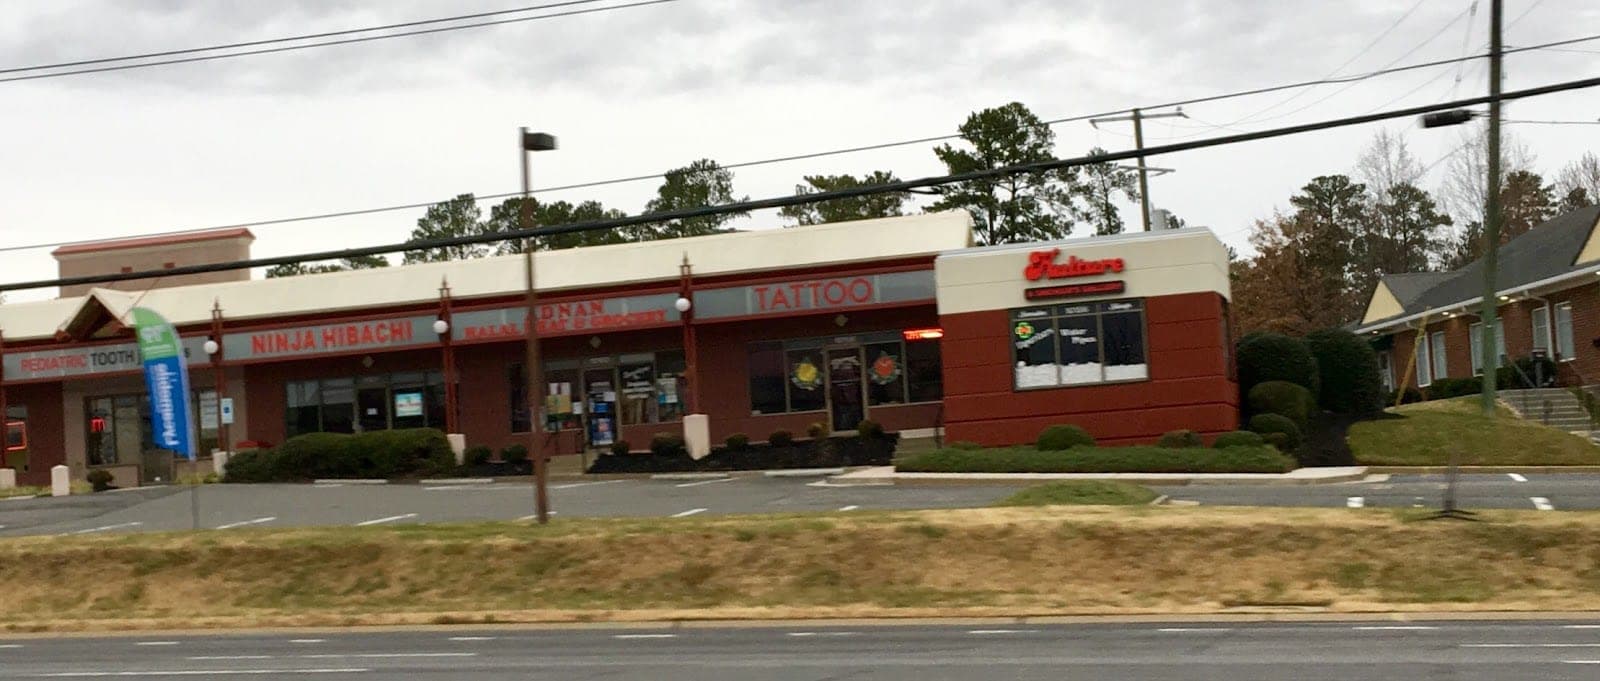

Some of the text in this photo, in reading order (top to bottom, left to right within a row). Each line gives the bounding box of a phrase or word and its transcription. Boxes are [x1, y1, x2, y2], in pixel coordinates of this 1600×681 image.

[753, 277, 874, 310] TATTOO
[251, 319, 413, 355] NINJA HIBACHI
[20, 354, 87, 373] PEDIATRIC
[91, 348, 136, 367] TOOTH
